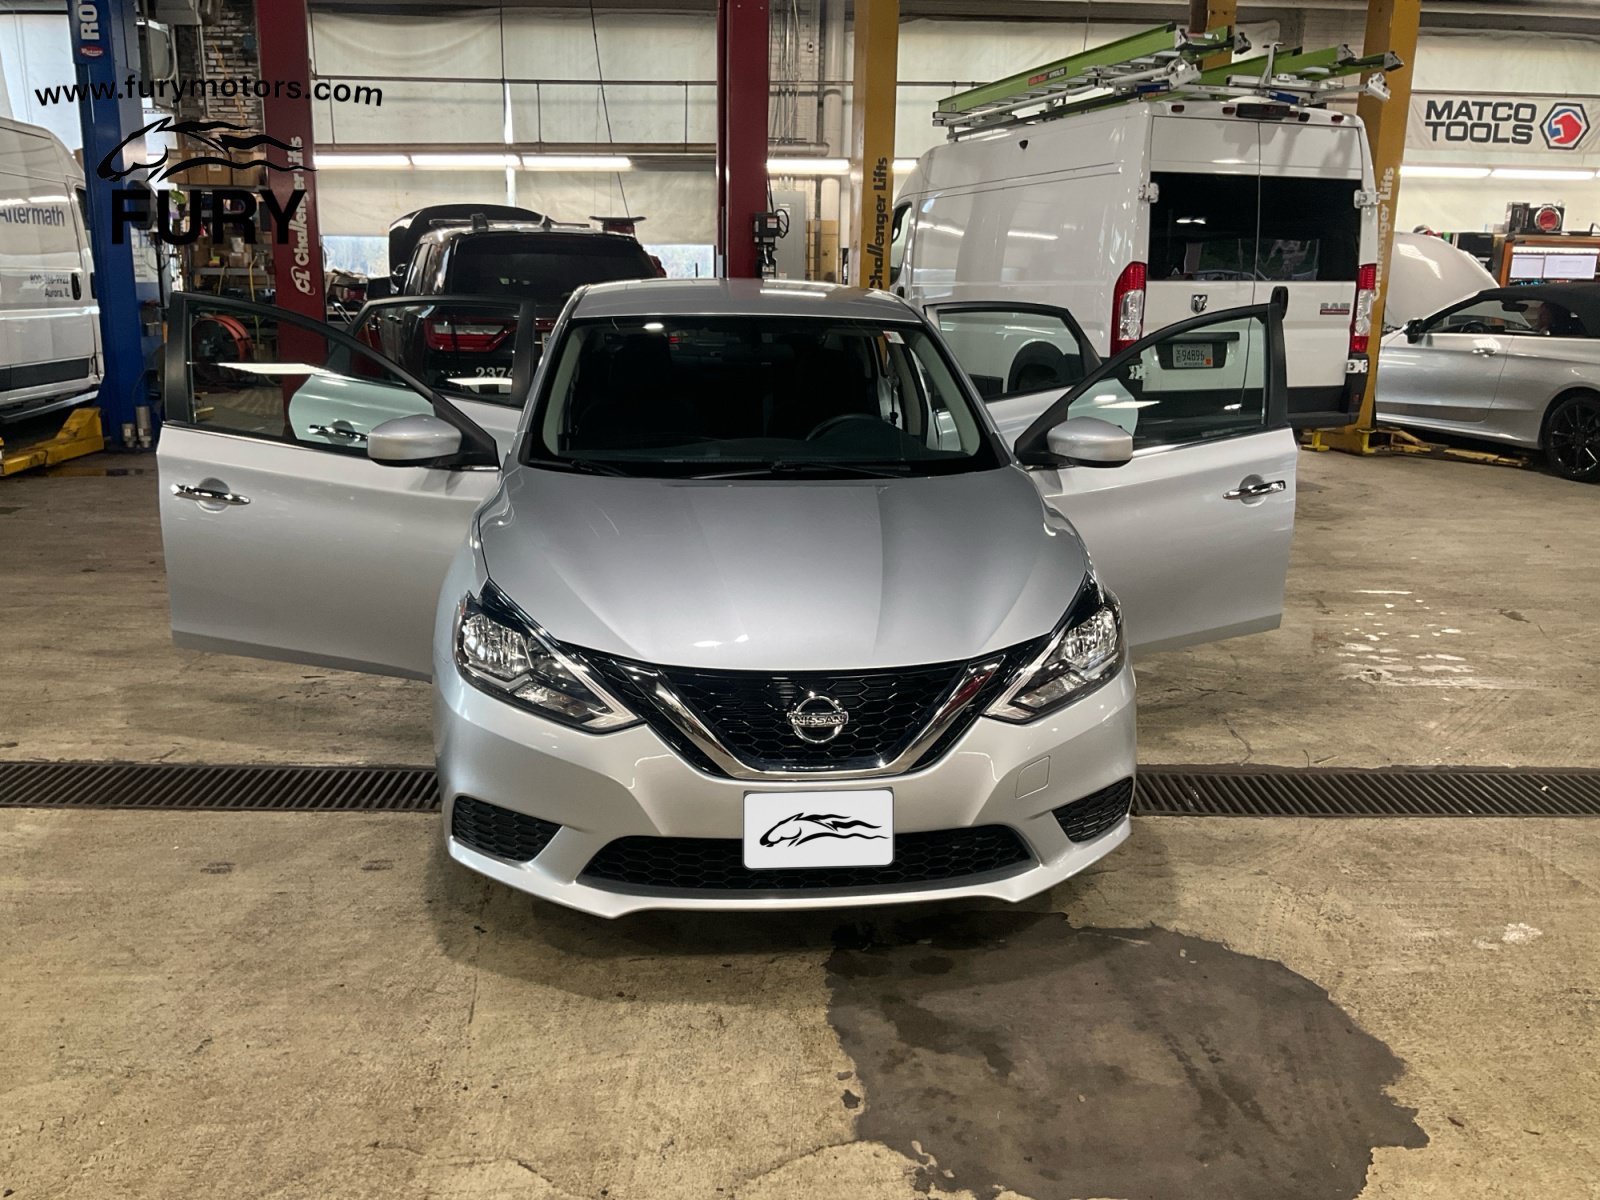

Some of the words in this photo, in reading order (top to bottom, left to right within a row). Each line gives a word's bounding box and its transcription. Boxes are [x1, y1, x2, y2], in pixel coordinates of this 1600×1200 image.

[78, 0, 100, 40] RO
[1426, 100, 1537, 123] MATCO
[1425, 121, 1534, 144] TOOLS
[873, 157, 888, 190] Lifts
[867, 195, 888, 289] Challenger
[793, 715, 843, 725] NISSAN
